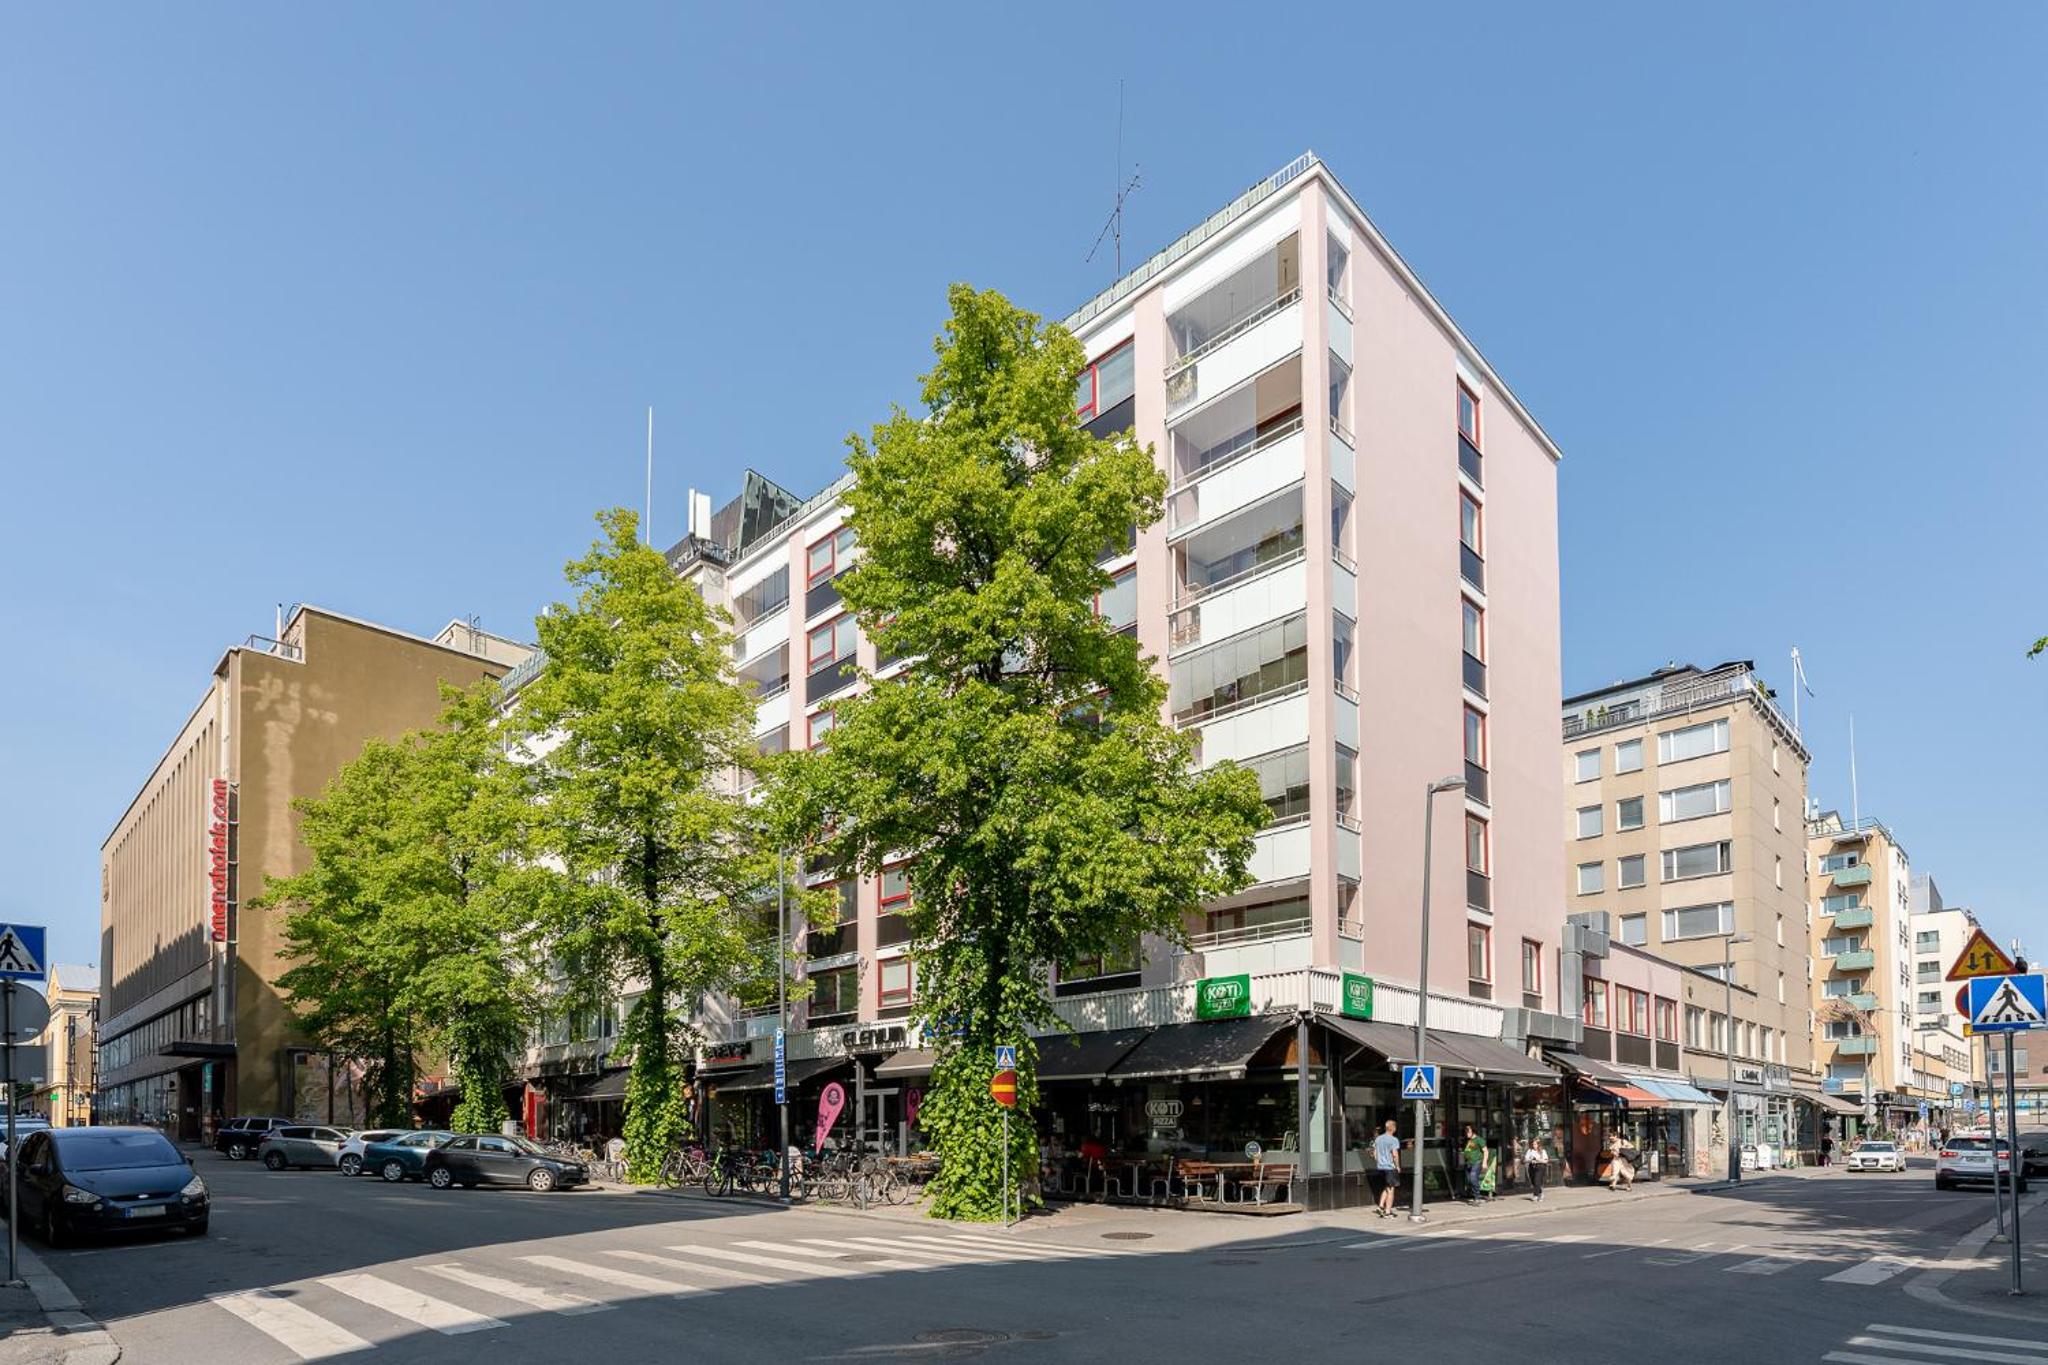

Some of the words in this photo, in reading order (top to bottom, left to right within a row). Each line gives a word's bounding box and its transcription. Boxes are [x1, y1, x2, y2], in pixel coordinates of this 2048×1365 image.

[1208, 984, 1238, 999] KOTI
[1150, 1102, 1179, 1115] KOTI
[1153, 1118, 1174, 1126] PIZZA
